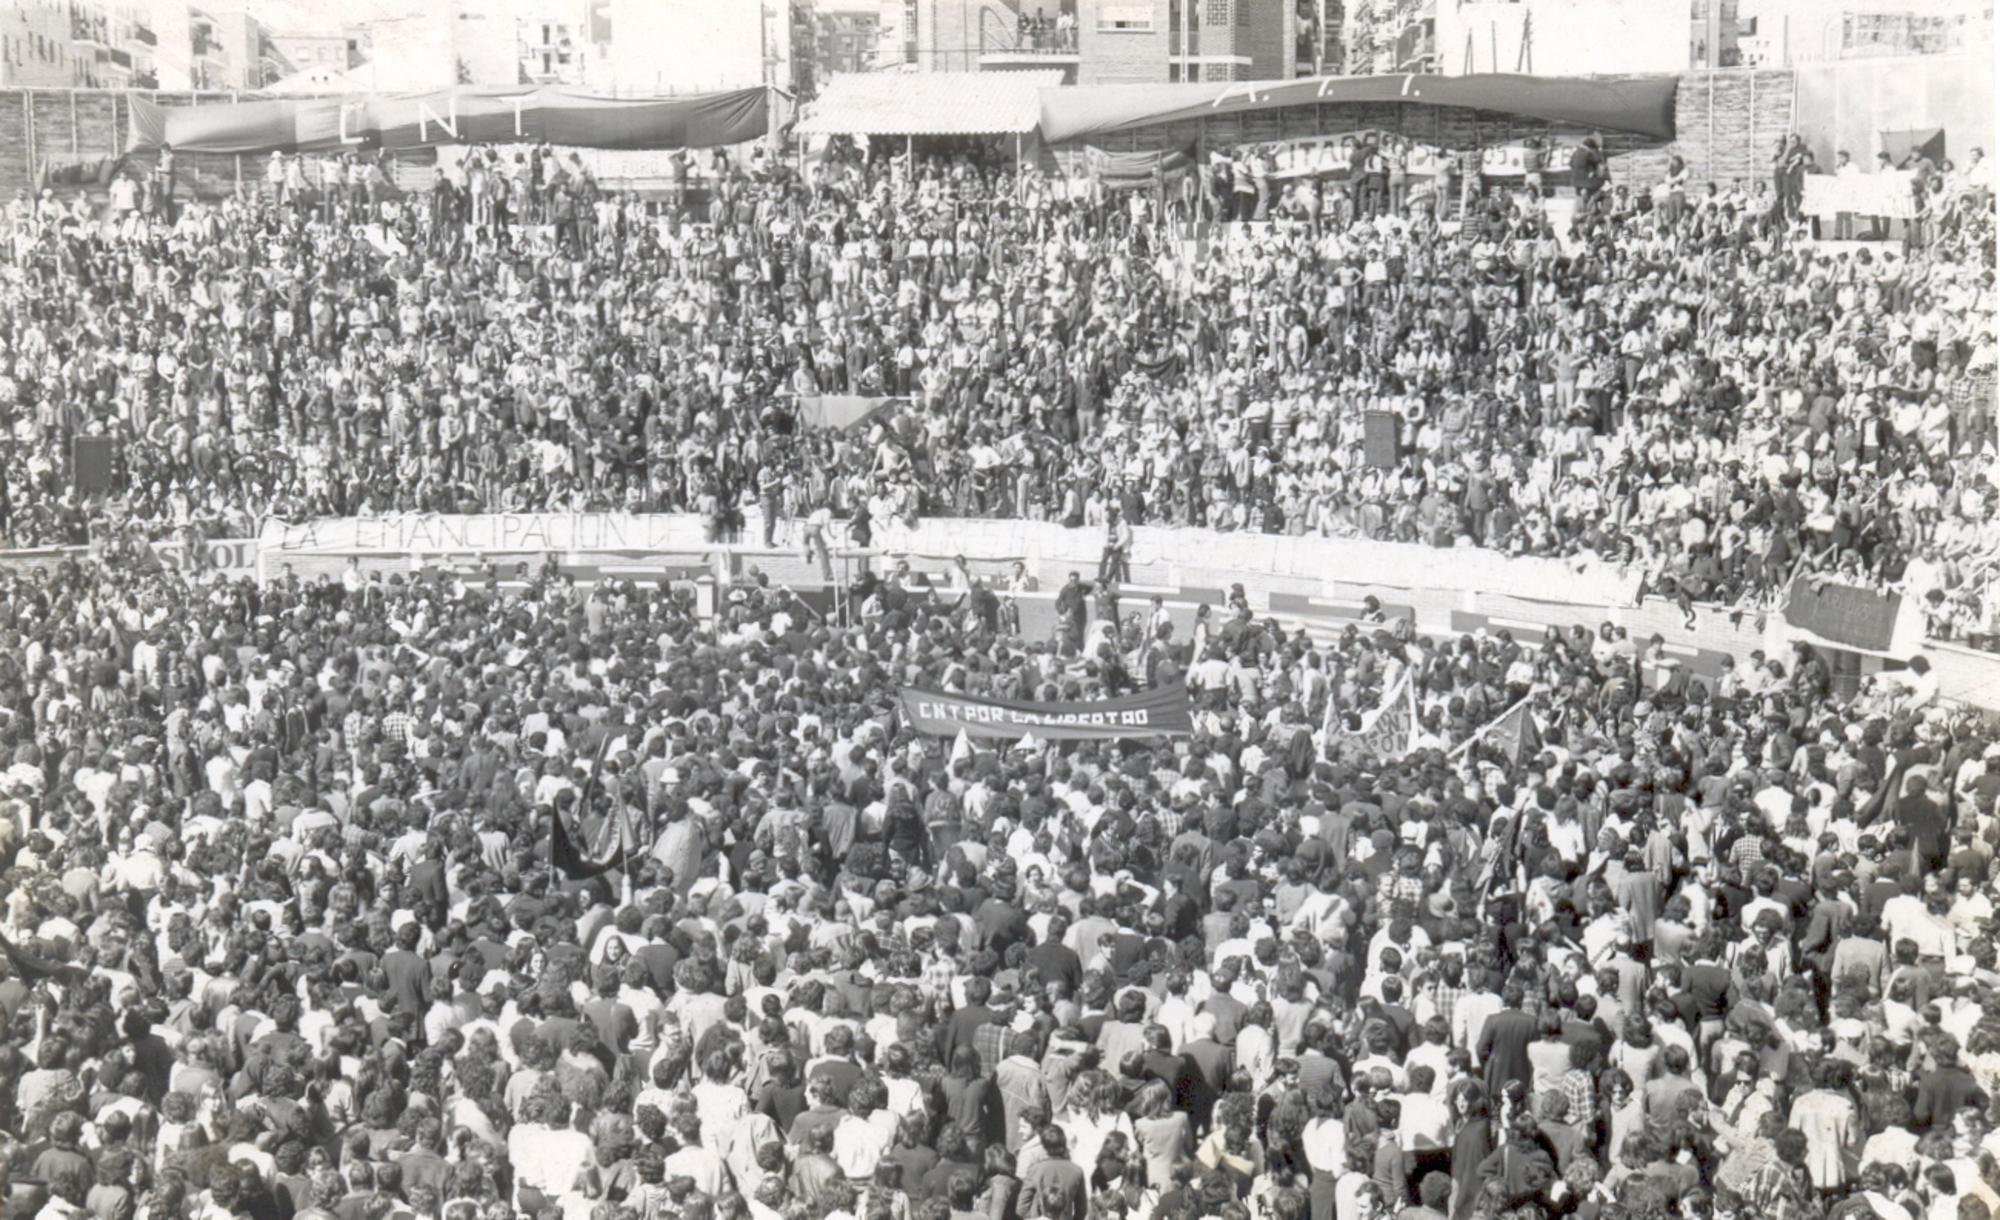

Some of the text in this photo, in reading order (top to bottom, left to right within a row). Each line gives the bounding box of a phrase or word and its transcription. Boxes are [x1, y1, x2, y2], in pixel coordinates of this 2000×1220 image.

[281, 525, 318, 550] LA
[356, 514, 627, 548] EMANCIPACION
[1684, 608, 1696, 632] 2
[919, 702, 960, 720] CNT
[964, 706, 1004, 723] POR
